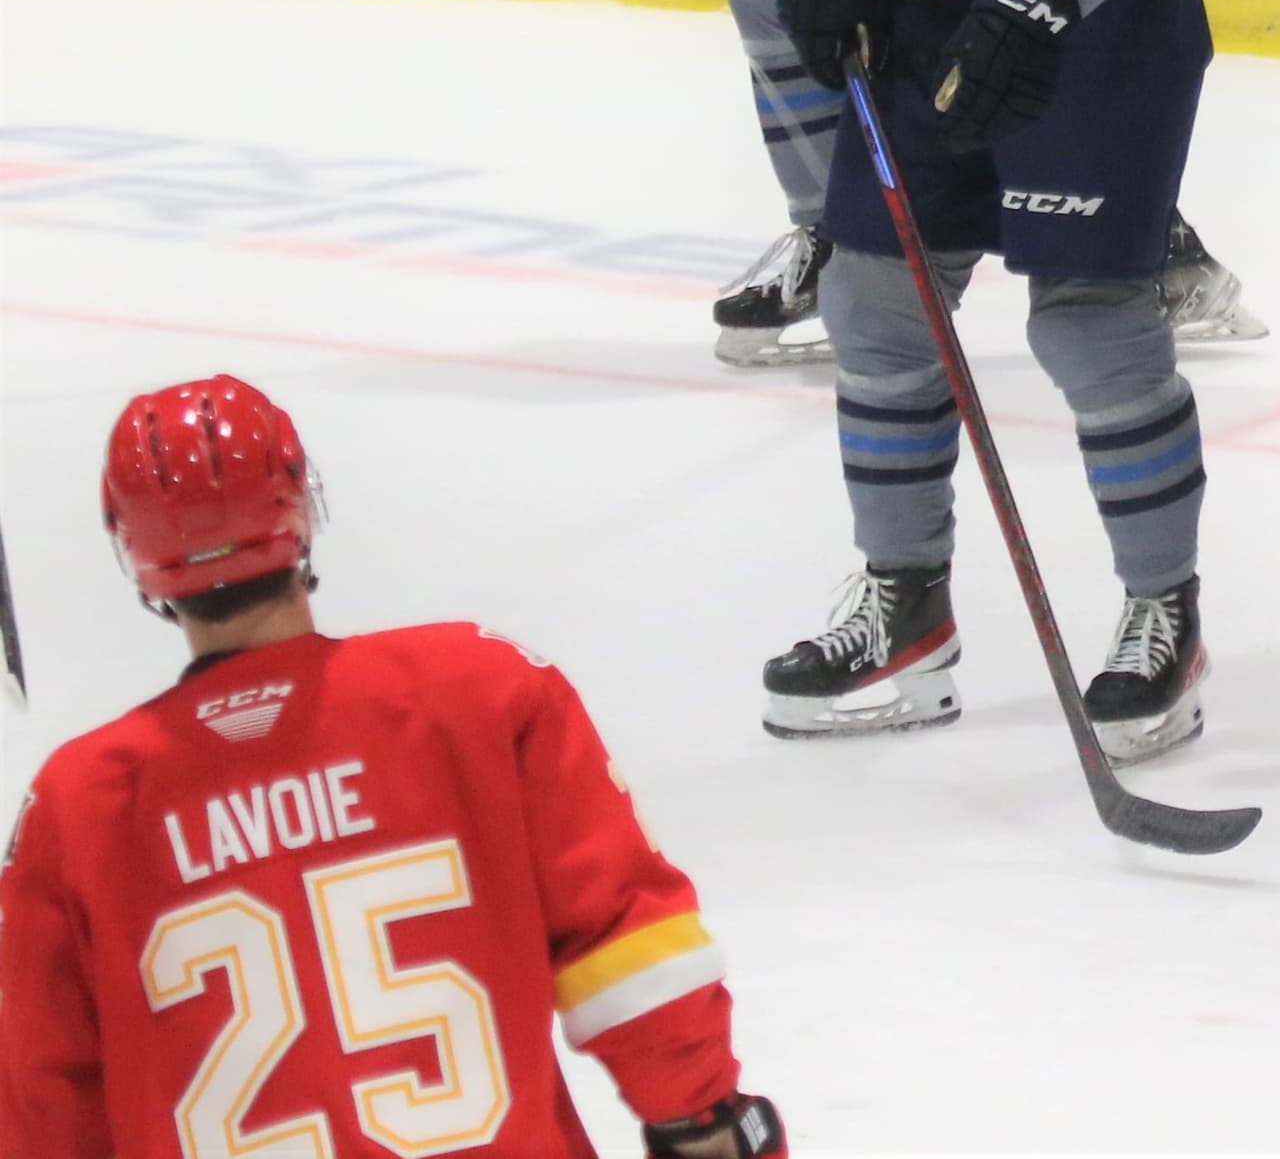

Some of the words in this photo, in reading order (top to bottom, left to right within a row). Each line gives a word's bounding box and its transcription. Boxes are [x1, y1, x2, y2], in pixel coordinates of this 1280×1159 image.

[1002, 189, 1105, 217] CCM
[195, 683, 294, 721] CCM
[163, 759, 376, 885] LAVOIE
[138, 838, 512, 1159] 25
